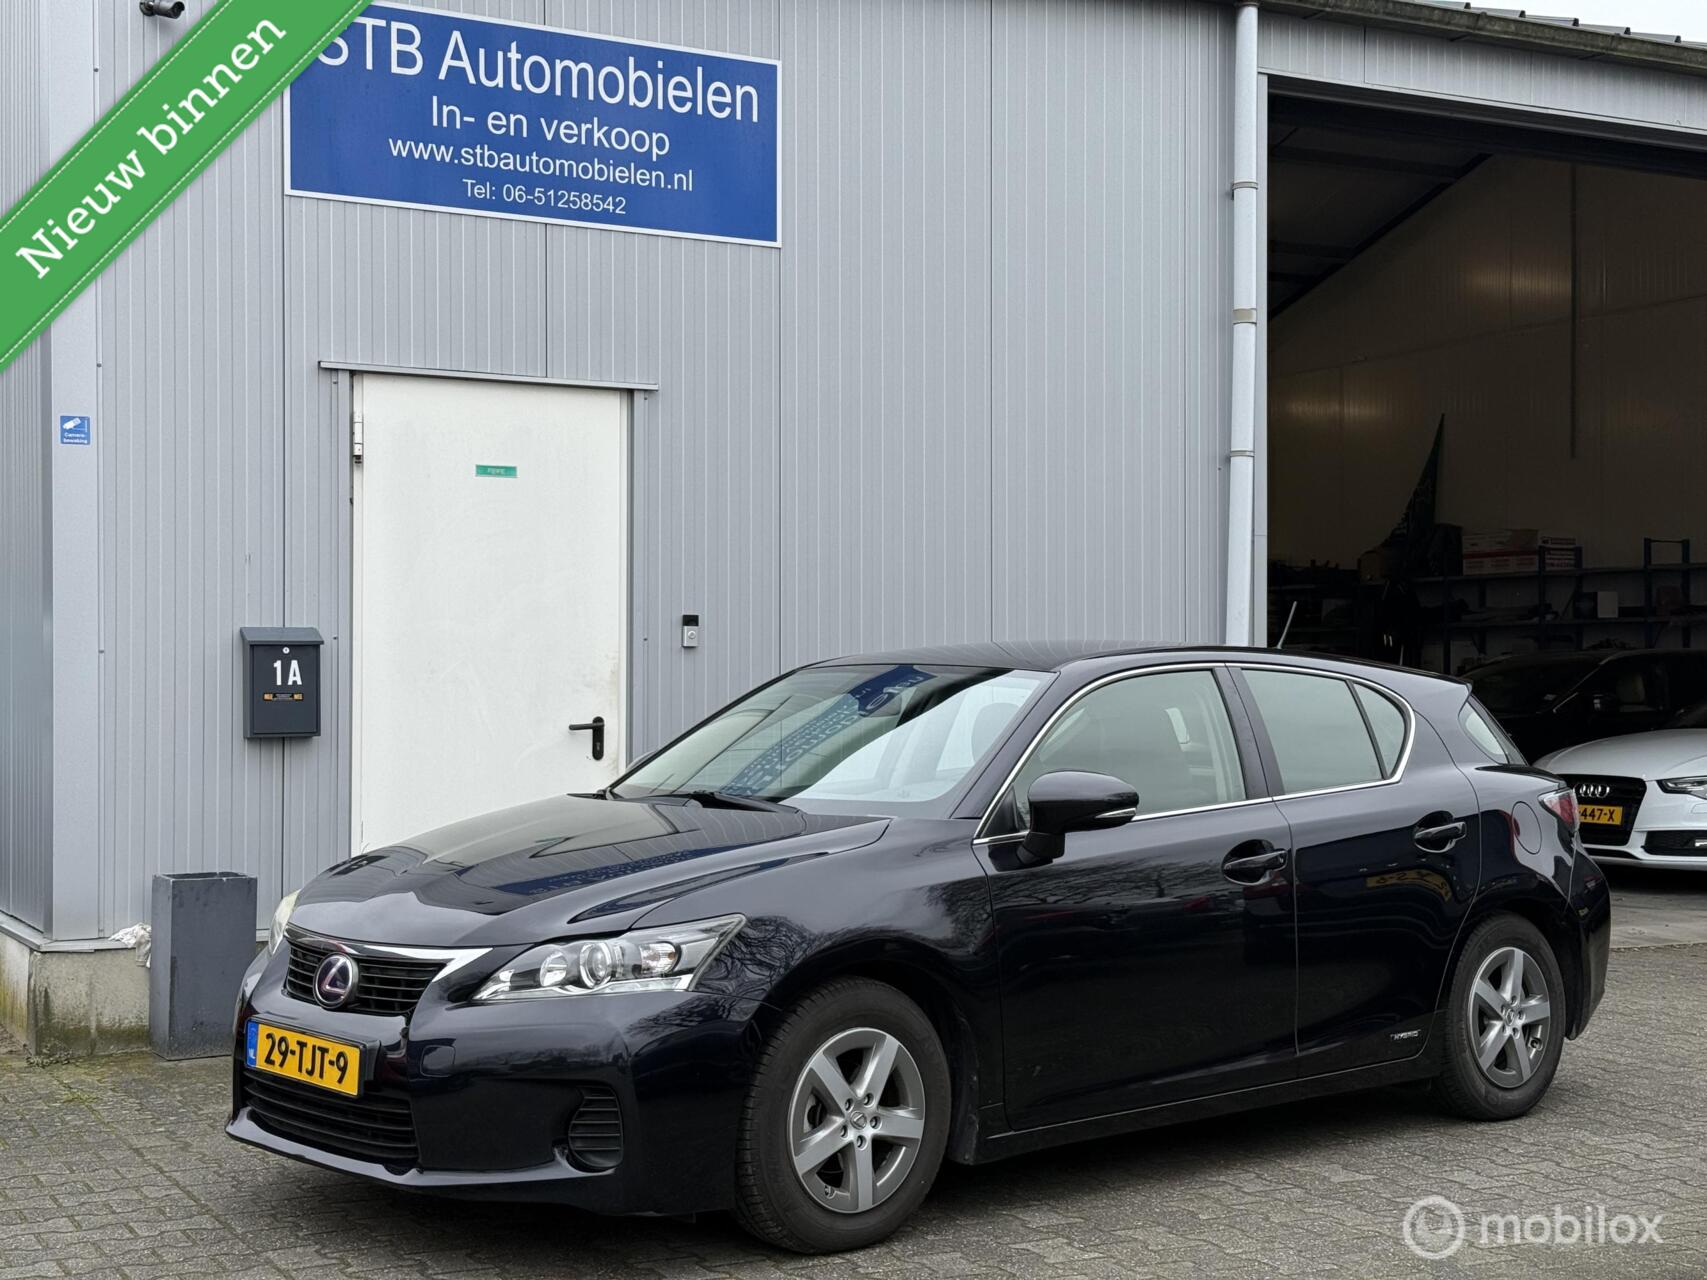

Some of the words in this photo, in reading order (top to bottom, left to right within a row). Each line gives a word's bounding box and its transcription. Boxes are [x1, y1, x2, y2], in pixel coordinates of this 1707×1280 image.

[438, 30, 758, 123] Automobielen
[432, 95, 475, 130] In-
[487, 111, 528, 138] en
[540, 116, 670, 162] verkoop
[388, 138, 693, 192] www.stbautomobielen.nl
[462, 178, 496, 201] Tel:
[502, 183, 626, 215] 06-51258542
[264, 1032, 349, 1085] 29-TJT-9
